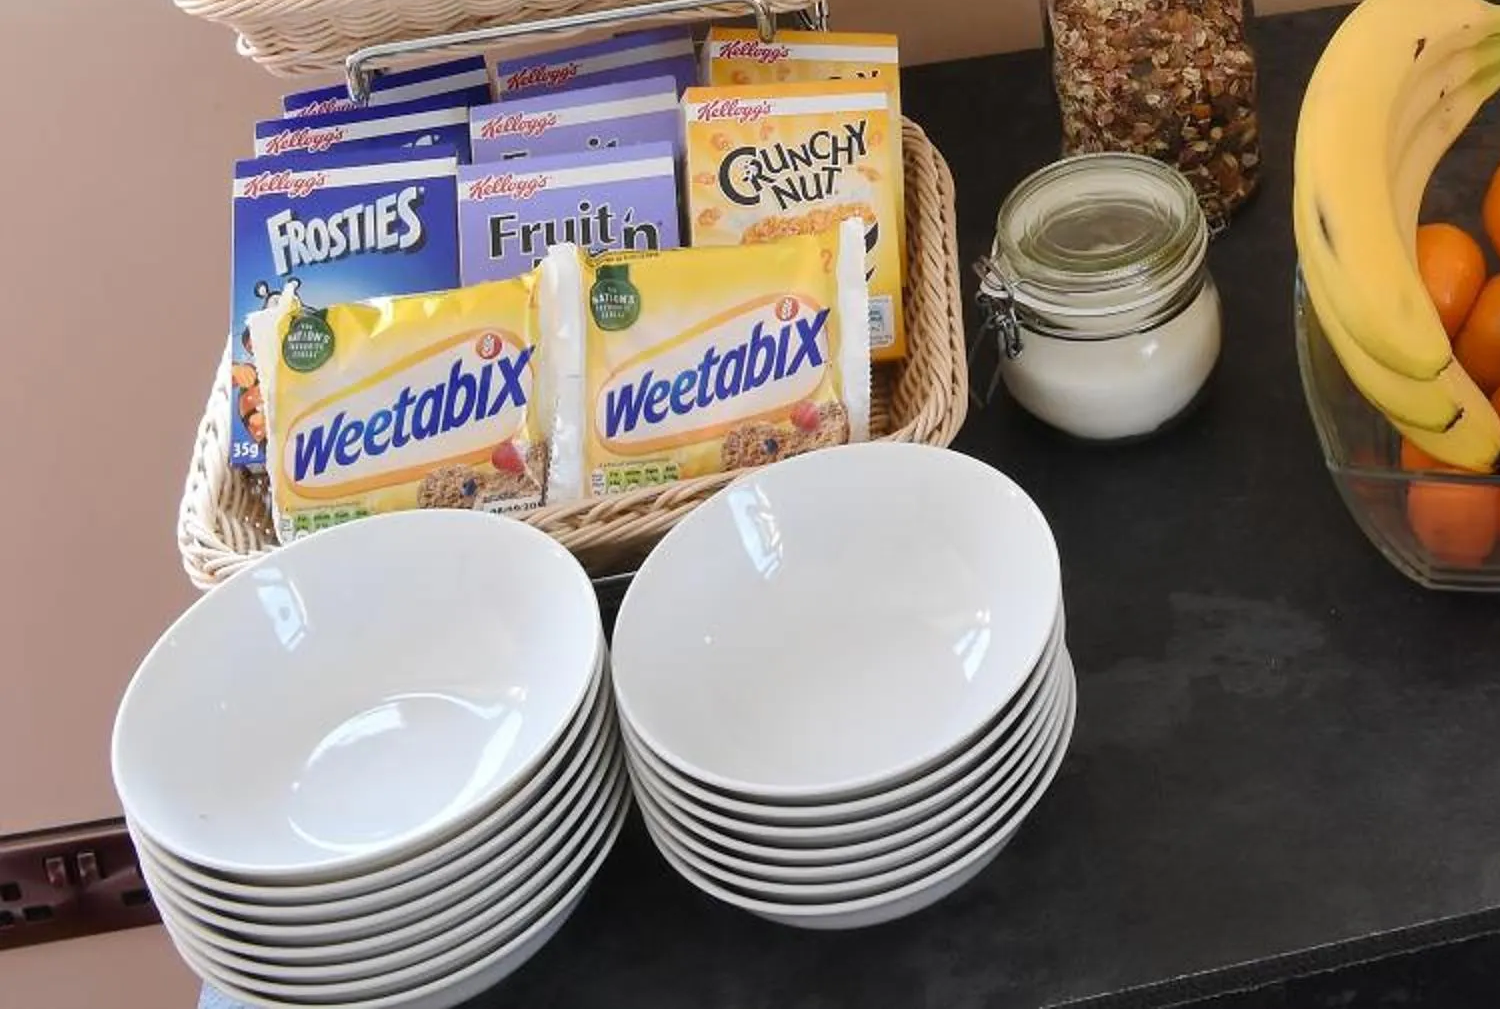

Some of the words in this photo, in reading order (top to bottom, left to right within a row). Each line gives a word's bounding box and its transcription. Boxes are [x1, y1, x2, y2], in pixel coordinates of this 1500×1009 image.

[719, 41, 790, 63] Kellogg's
[507, 64, 579, 90] Kellogg's
[697, 101, 772, 122] Kellogg's
[481, 114, 557, 138] Kellogg's
[265, 129, 345, 153] Kellogg's
[719, 120, 867, 206] CRUNCHY
[244, 173, 325, 197] Kellogg's
[469, 174, 549, 199] Kellogg's
[771, 167, 842, 211] NUT
[266, 188, 422, 275] FROSTIES
[489, 202, 616, 259] Fruit
[605, 308, 830, 438] Weetabix
[294, 345, 535, 482] Weetabix
[232, 443, 259, 459] 35g
